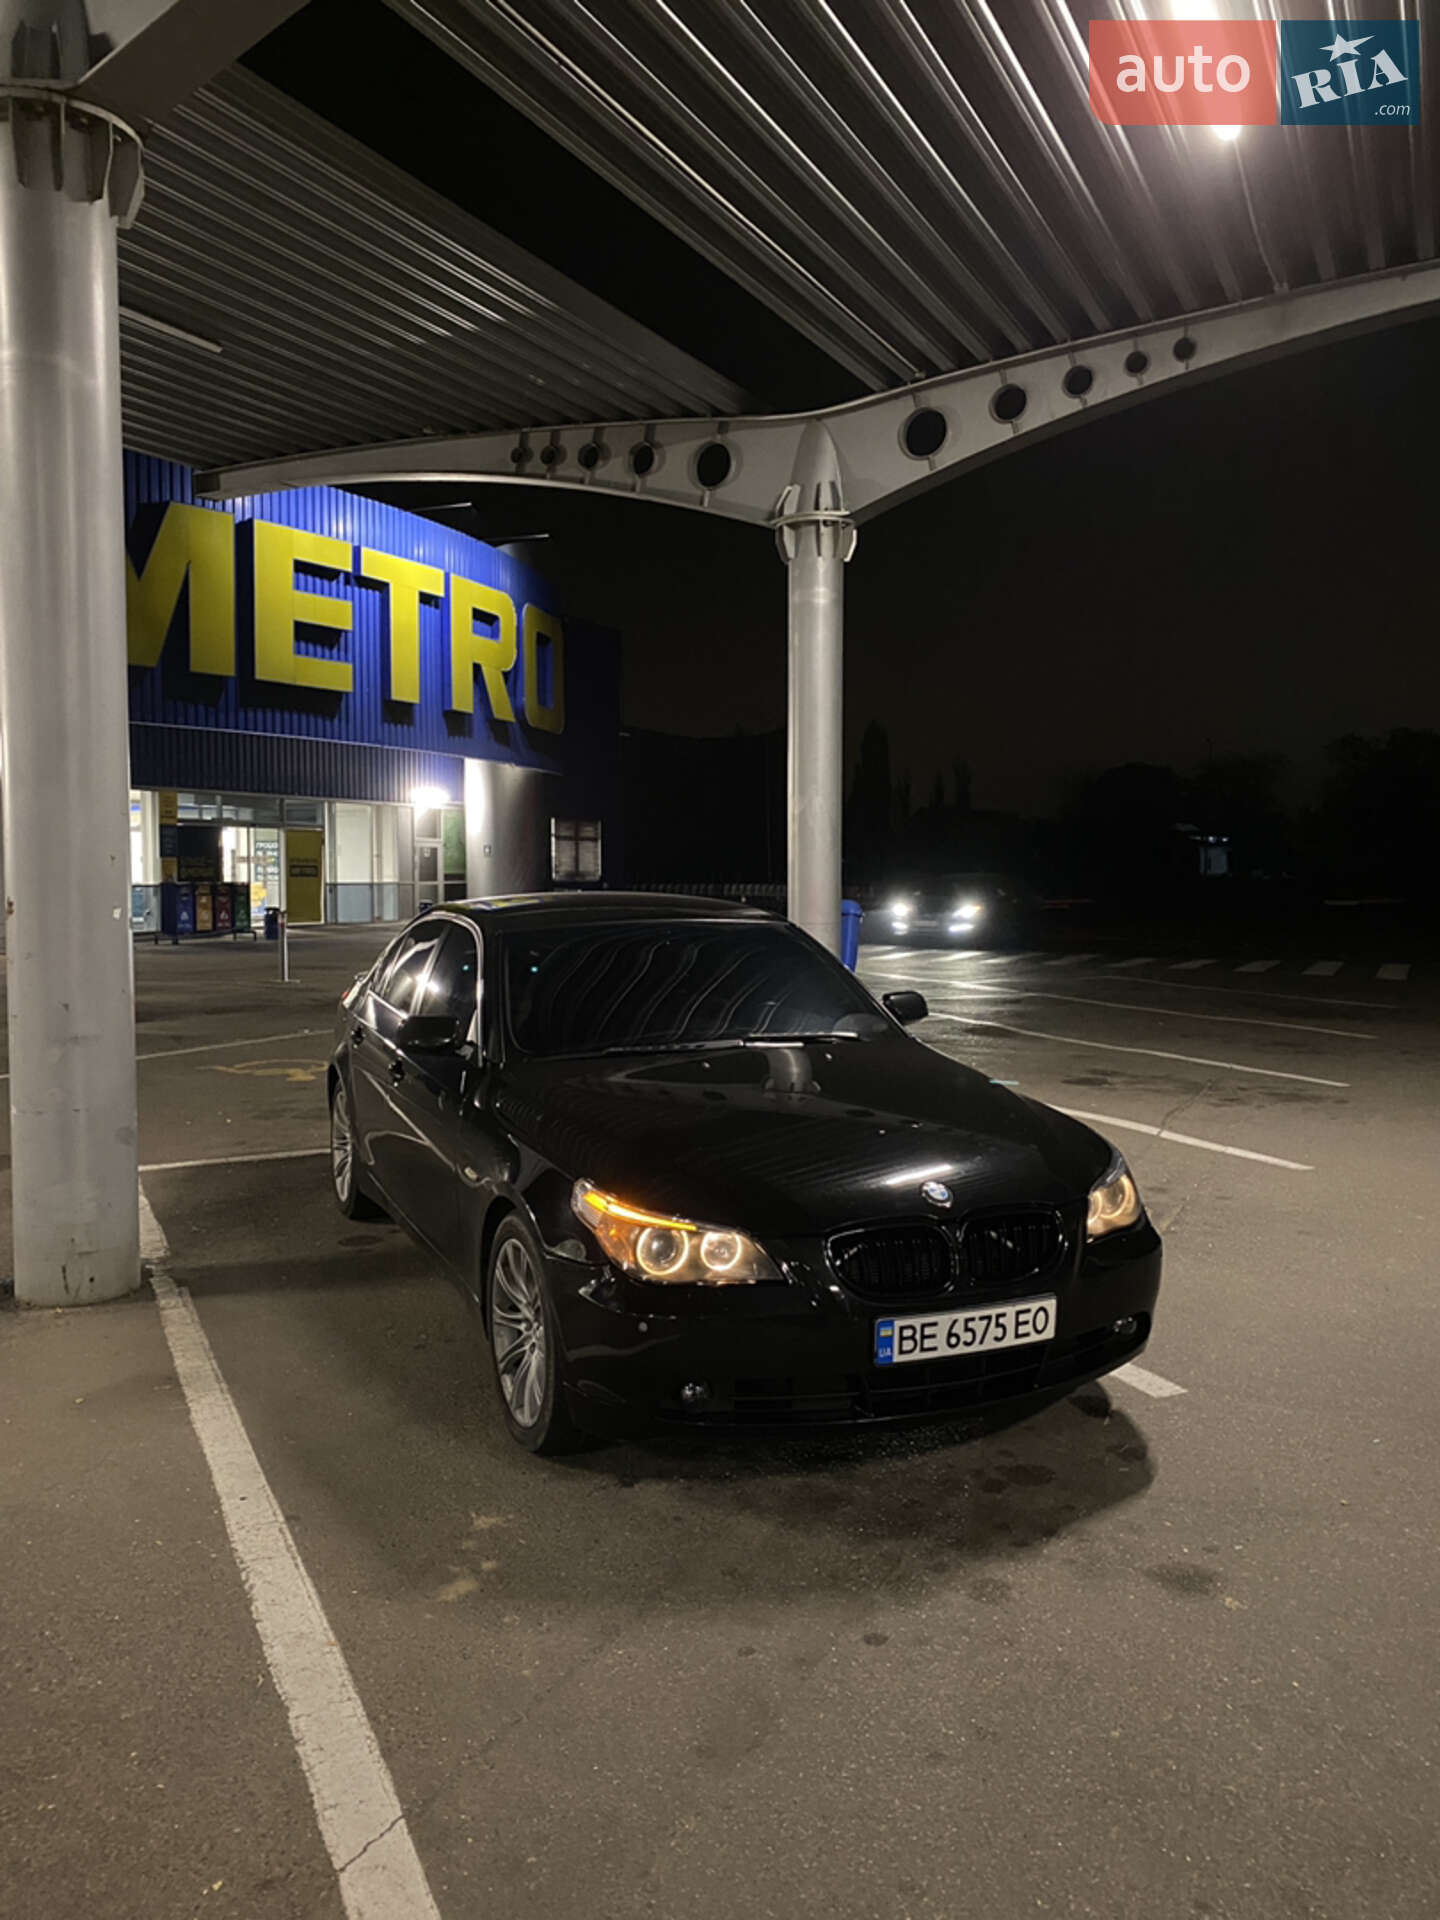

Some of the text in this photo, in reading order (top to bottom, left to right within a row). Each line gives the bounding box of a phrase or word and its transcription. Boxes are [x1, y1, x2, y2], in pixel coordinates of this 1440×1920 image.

[127, 501, 565, 735] METRO
[898, 1306, 1049, 1356] BE 6575 EO
